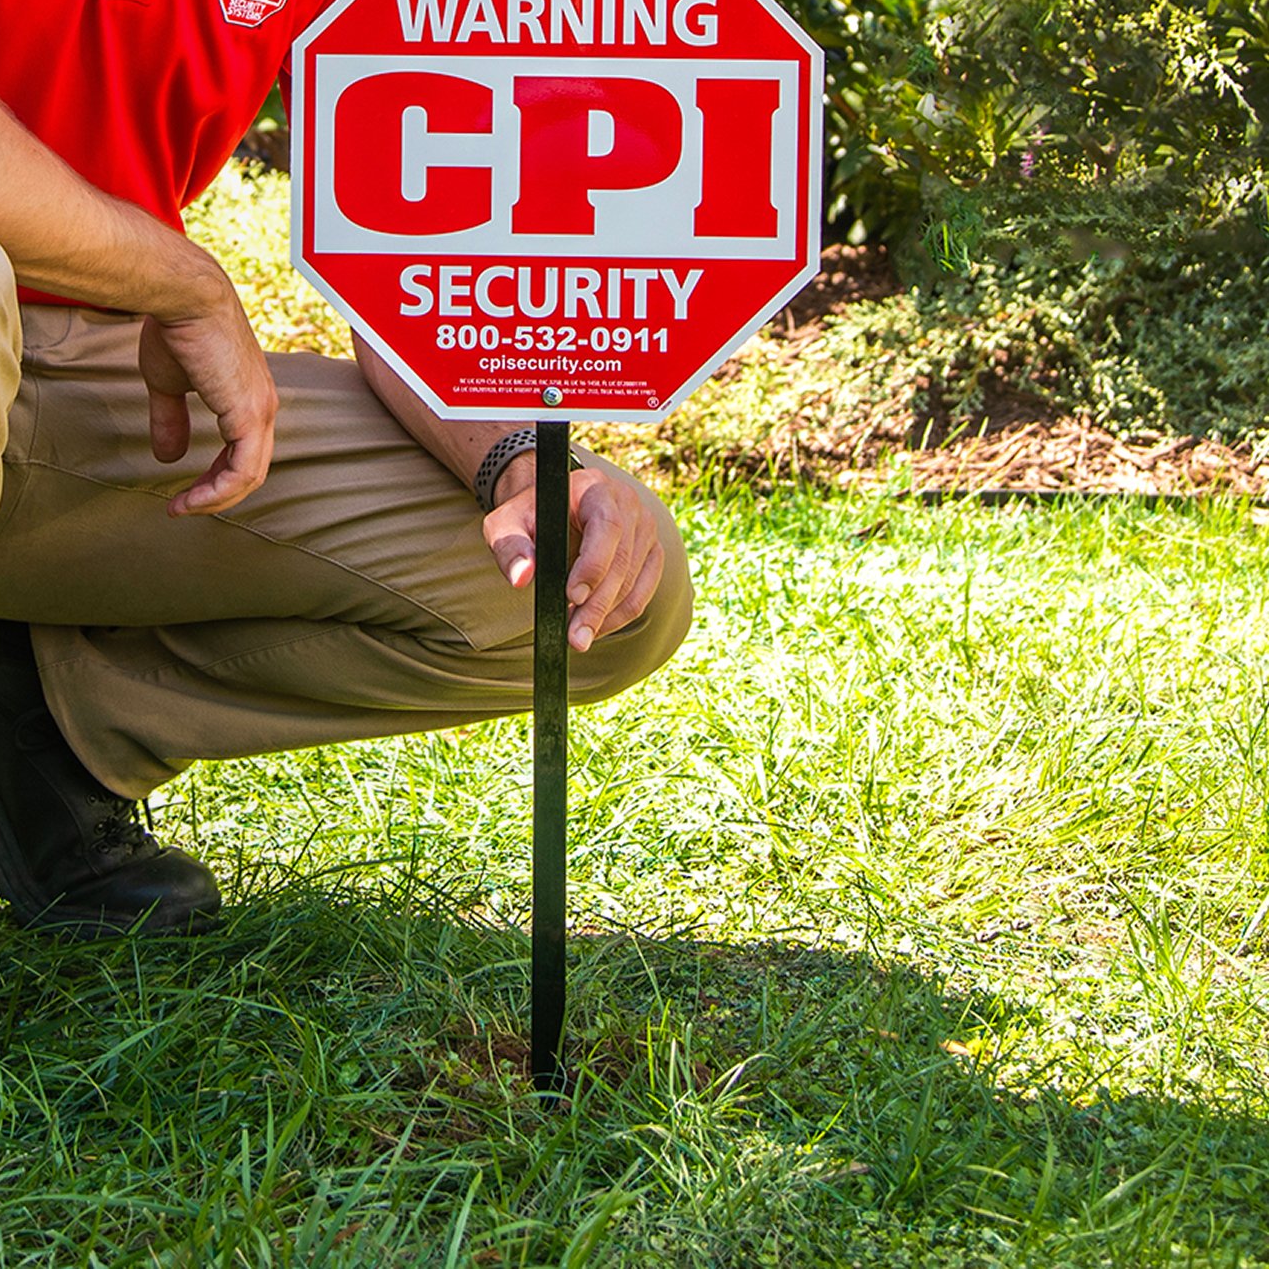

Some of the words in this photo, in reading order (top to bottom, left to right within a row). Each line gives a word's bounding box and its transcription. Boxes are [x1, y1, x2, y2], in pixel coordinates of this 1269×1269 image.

[333, 71, 781, 239] CPI
[399, 265, 704, 320] SECURITY
[435, 324, 669, 354] 800-532-0911
[478, 354, 623, 374] cpisecurity.com
